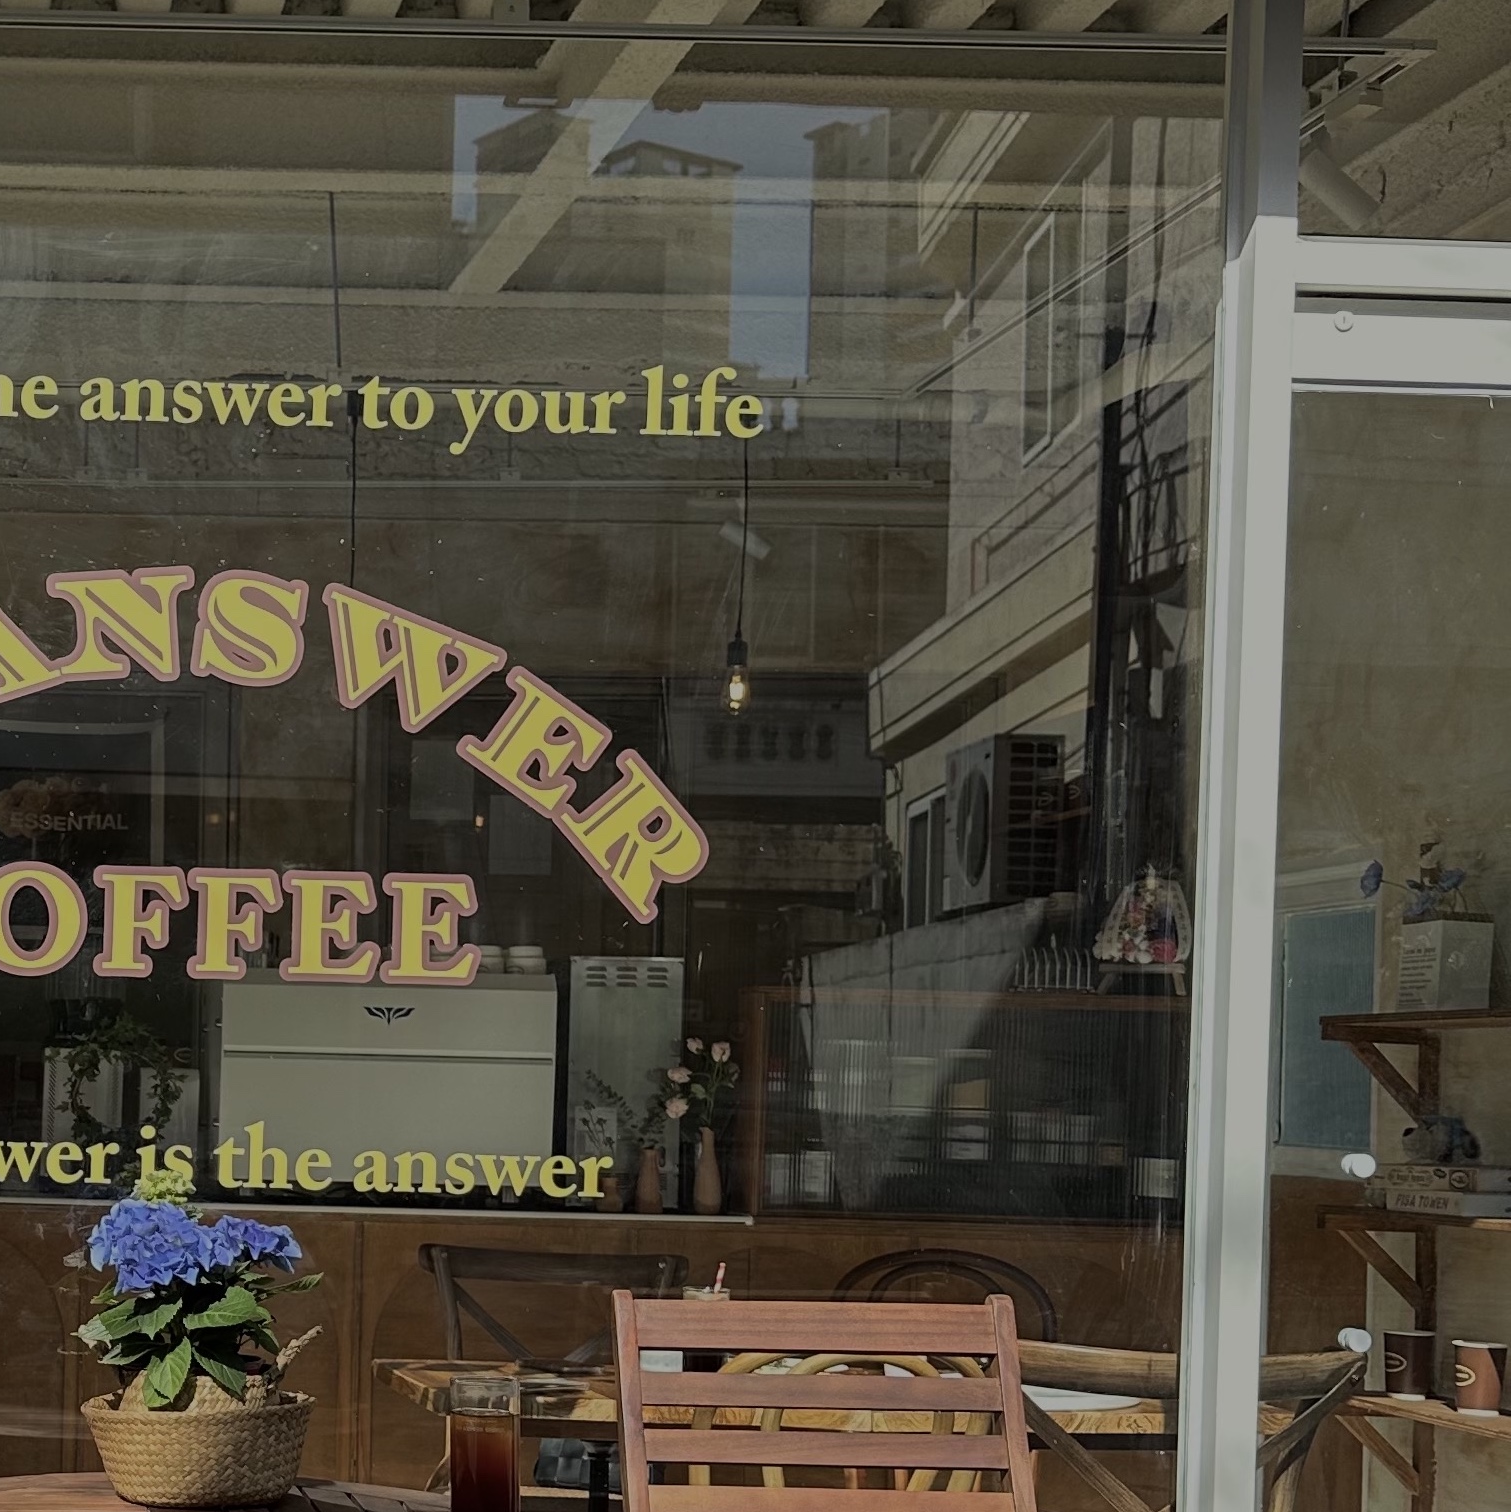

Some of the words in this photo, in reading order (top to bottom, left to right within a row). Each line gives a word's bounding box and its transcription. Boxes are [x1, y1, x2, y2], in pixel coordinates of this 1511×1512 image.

[79, 375, 342, 427] answer
[359, 376, 435, 430] to
[449, 384, 627, 455] your
[640, 364, 764, 439] life
[9, 810, 129, 832] ESSENTIAL
[135, 1124, 194, 1188] is
[213, 1120, 334, 1192] the
[353, 1148, 615, 1199] answer
